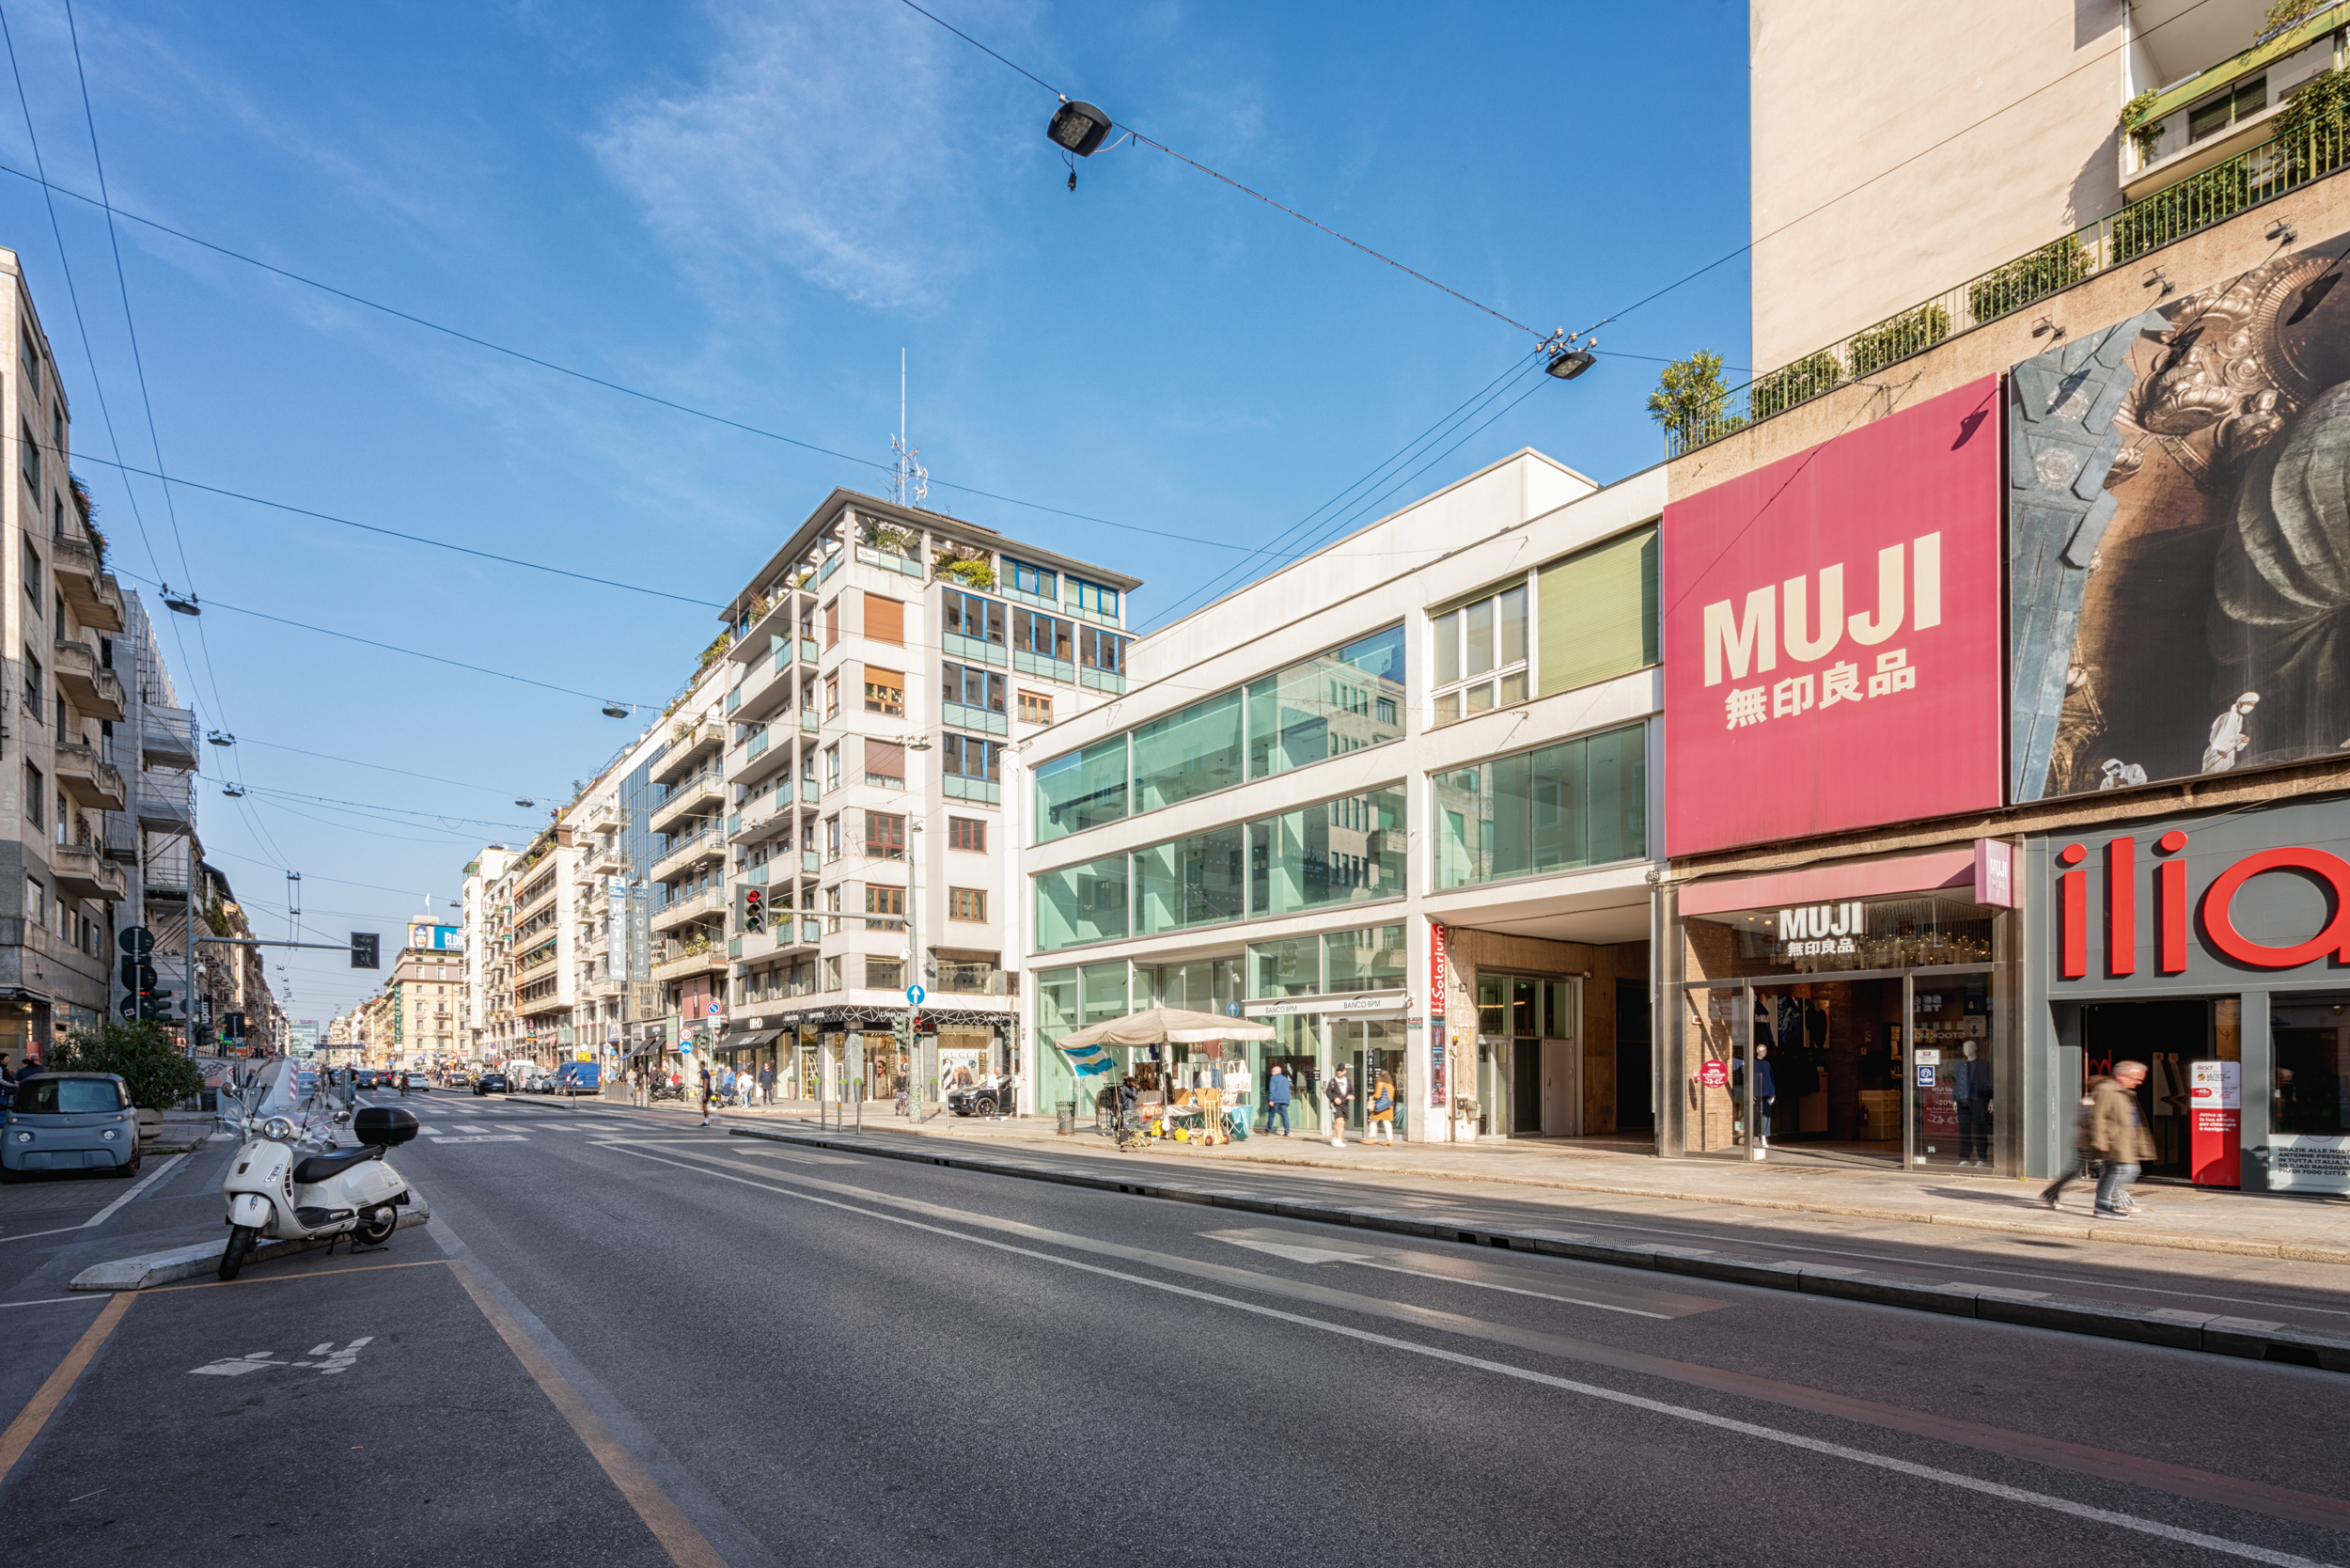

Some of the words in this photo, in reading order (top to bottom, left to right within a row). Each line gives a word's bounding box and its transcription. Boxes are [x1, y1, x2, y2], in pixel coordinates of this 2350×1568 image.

[1704, 531, 1940, 687] MUJI
[1725, 648, 1915, 730] 無印良品
[1649, 870, 1659, 879] 36
[1990, 858, 2007, 878] MUJI
[1779, 902, 1863, 940] MUJI
[2062, 830, 2350, 977] ilia
[445, 932, 463, 946] ELDO
[613, 902, 622, 964] HOTEL
[1787, 938, 1856, 957] 無印良品
[1432, 925, 1444, 1000] Solarium
[201, 1002, 212, 1023] upim
